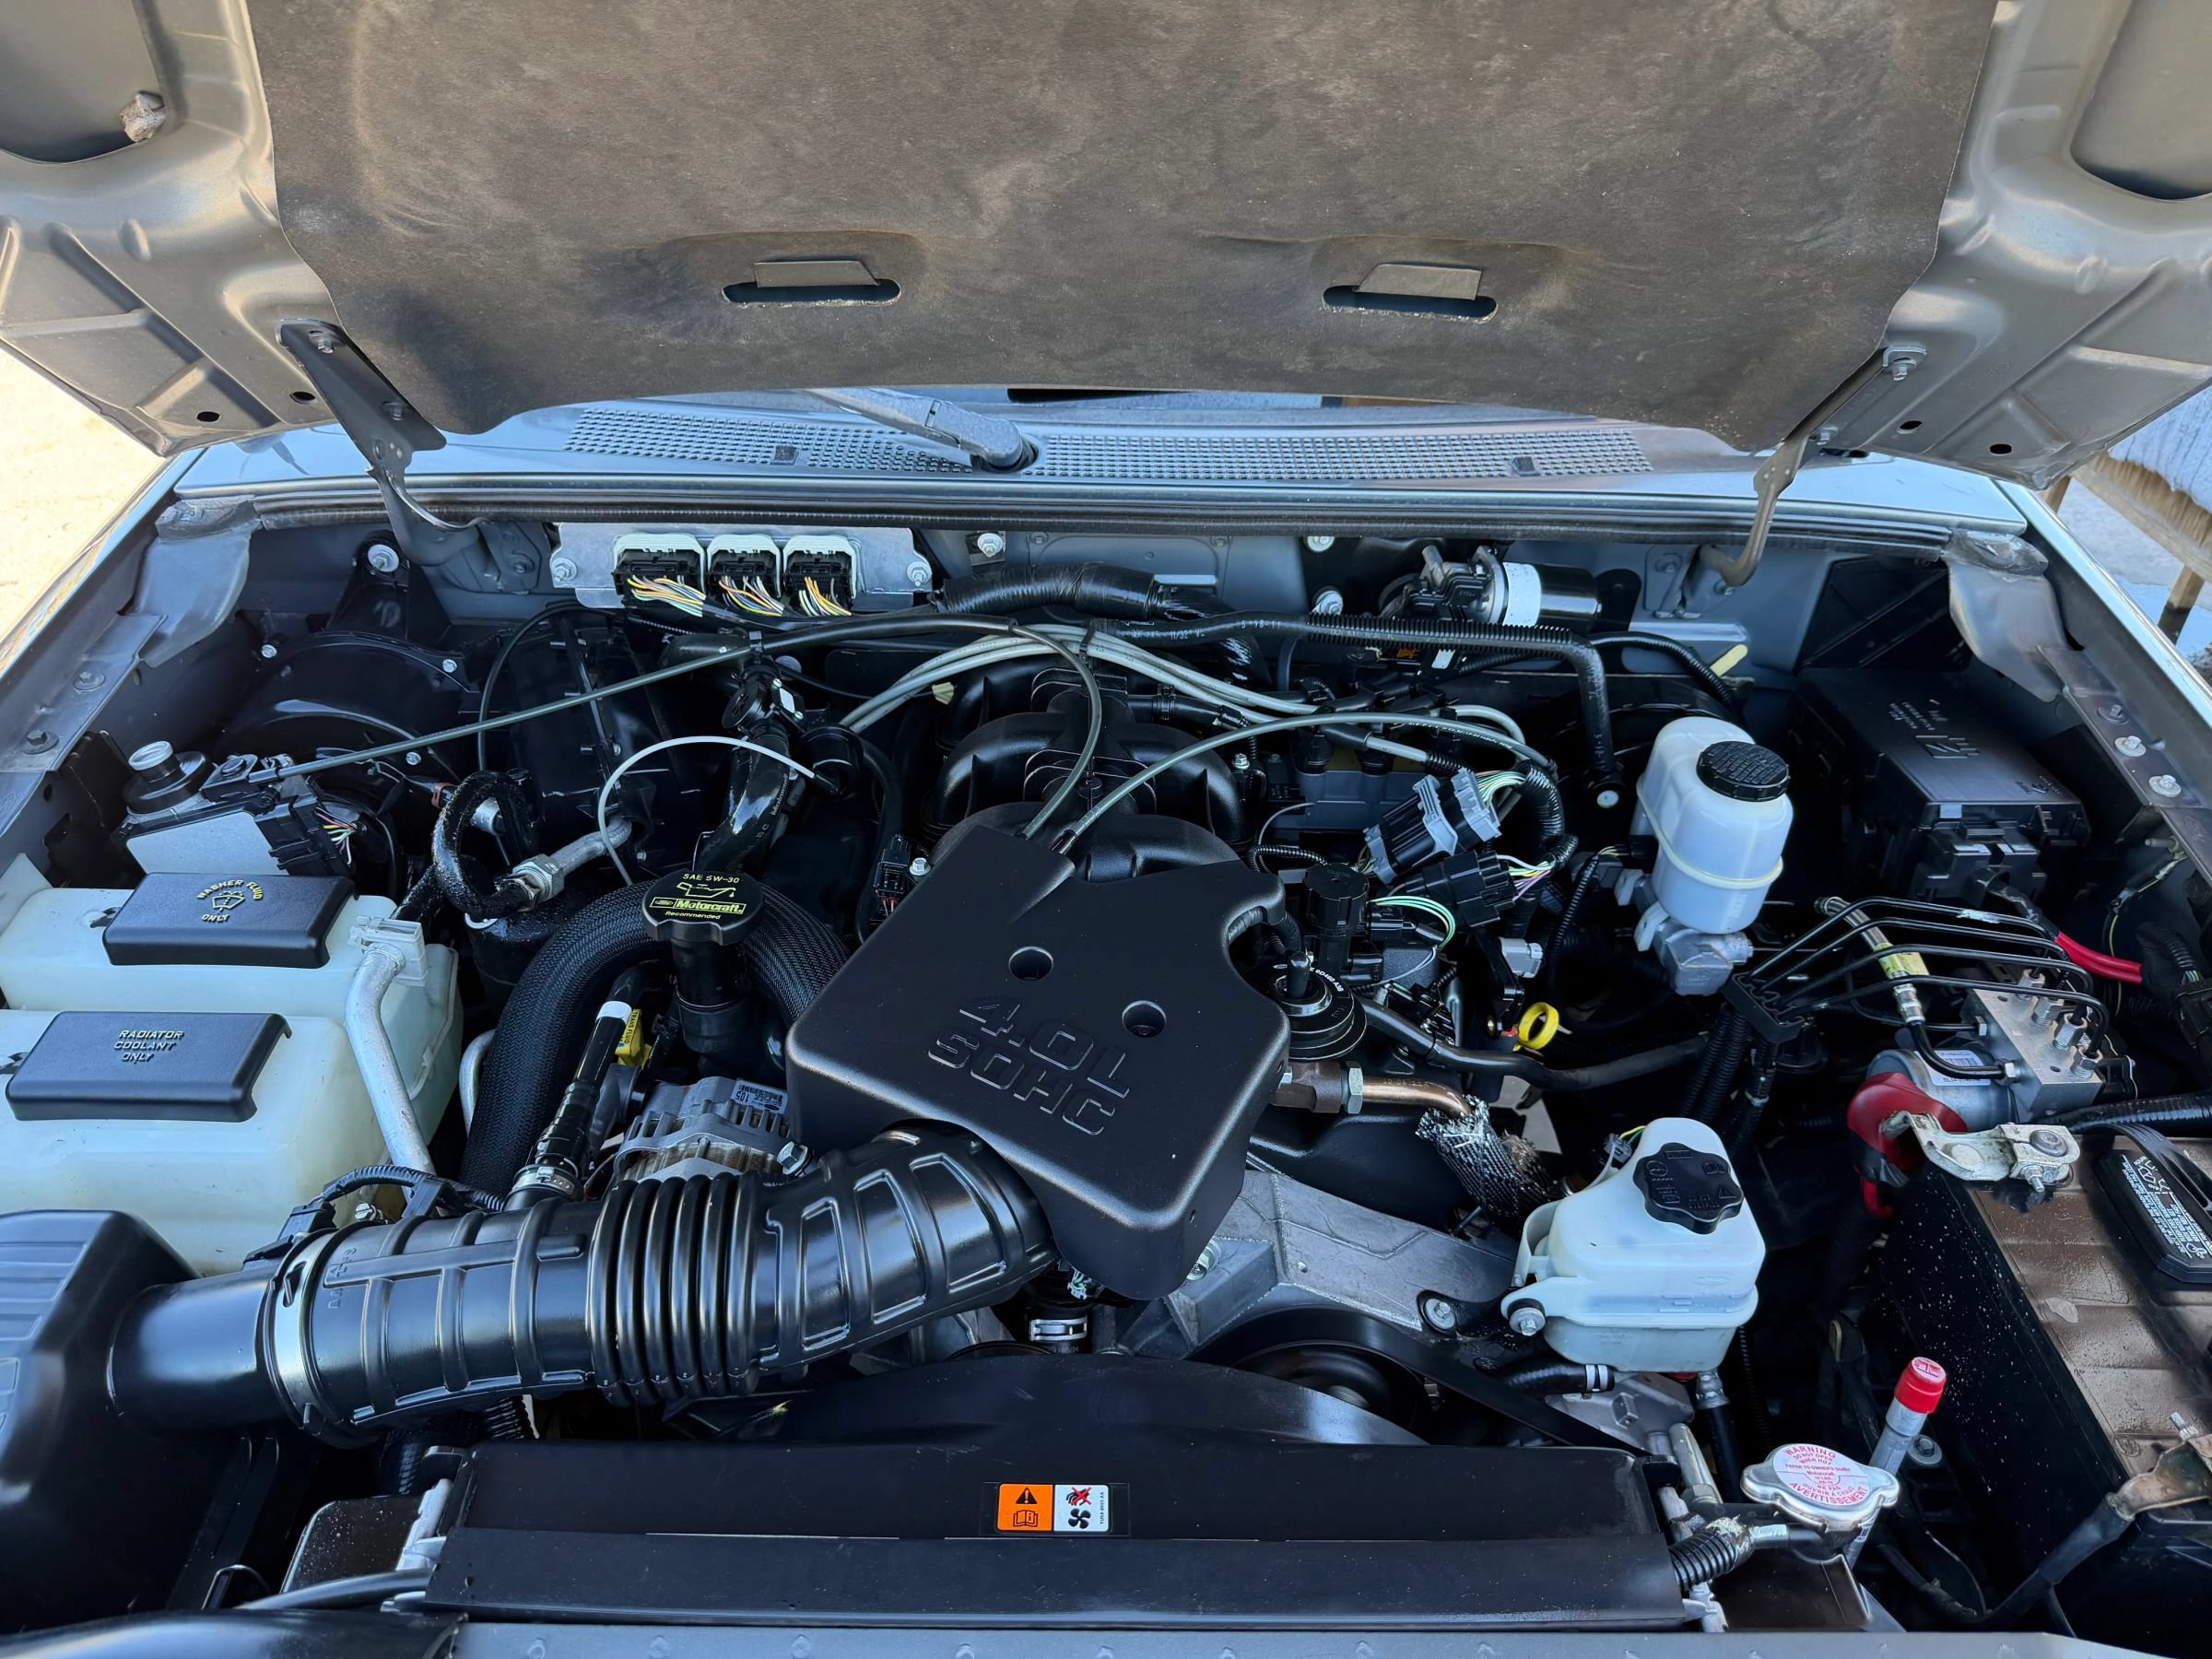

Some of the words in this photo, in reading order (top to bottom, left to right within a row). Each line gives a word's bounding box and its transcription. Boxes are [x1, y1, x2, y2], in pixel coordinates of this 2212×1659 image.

[705, 876, 739, 884] 5W-30
[196, 879, 244, 899] WASHER
[245, 881, 264, 900] FLUID
[202, 913, 230, 923] ONLY
[665, 911, 721, 920] Recommended
[628, 1011, 639, 1029] TRANS
[118, 1030, 184, 1041] RADIATOR
[623, 1029, 634, 1044] FLUID
[113, 1041, 177, 1052] COOLANT
[958, 996, 1131, 1099] 4.0L
[121, 1052, 155, 1062] ONLY
[927, 1029, 1116, 1135] SOHC
[735, 1090, 750, 1103] 105
[1783, 1445, 1836, 1459] WARNING
[1788, 1482, 1867, 1505] AVERTISSEMENT
